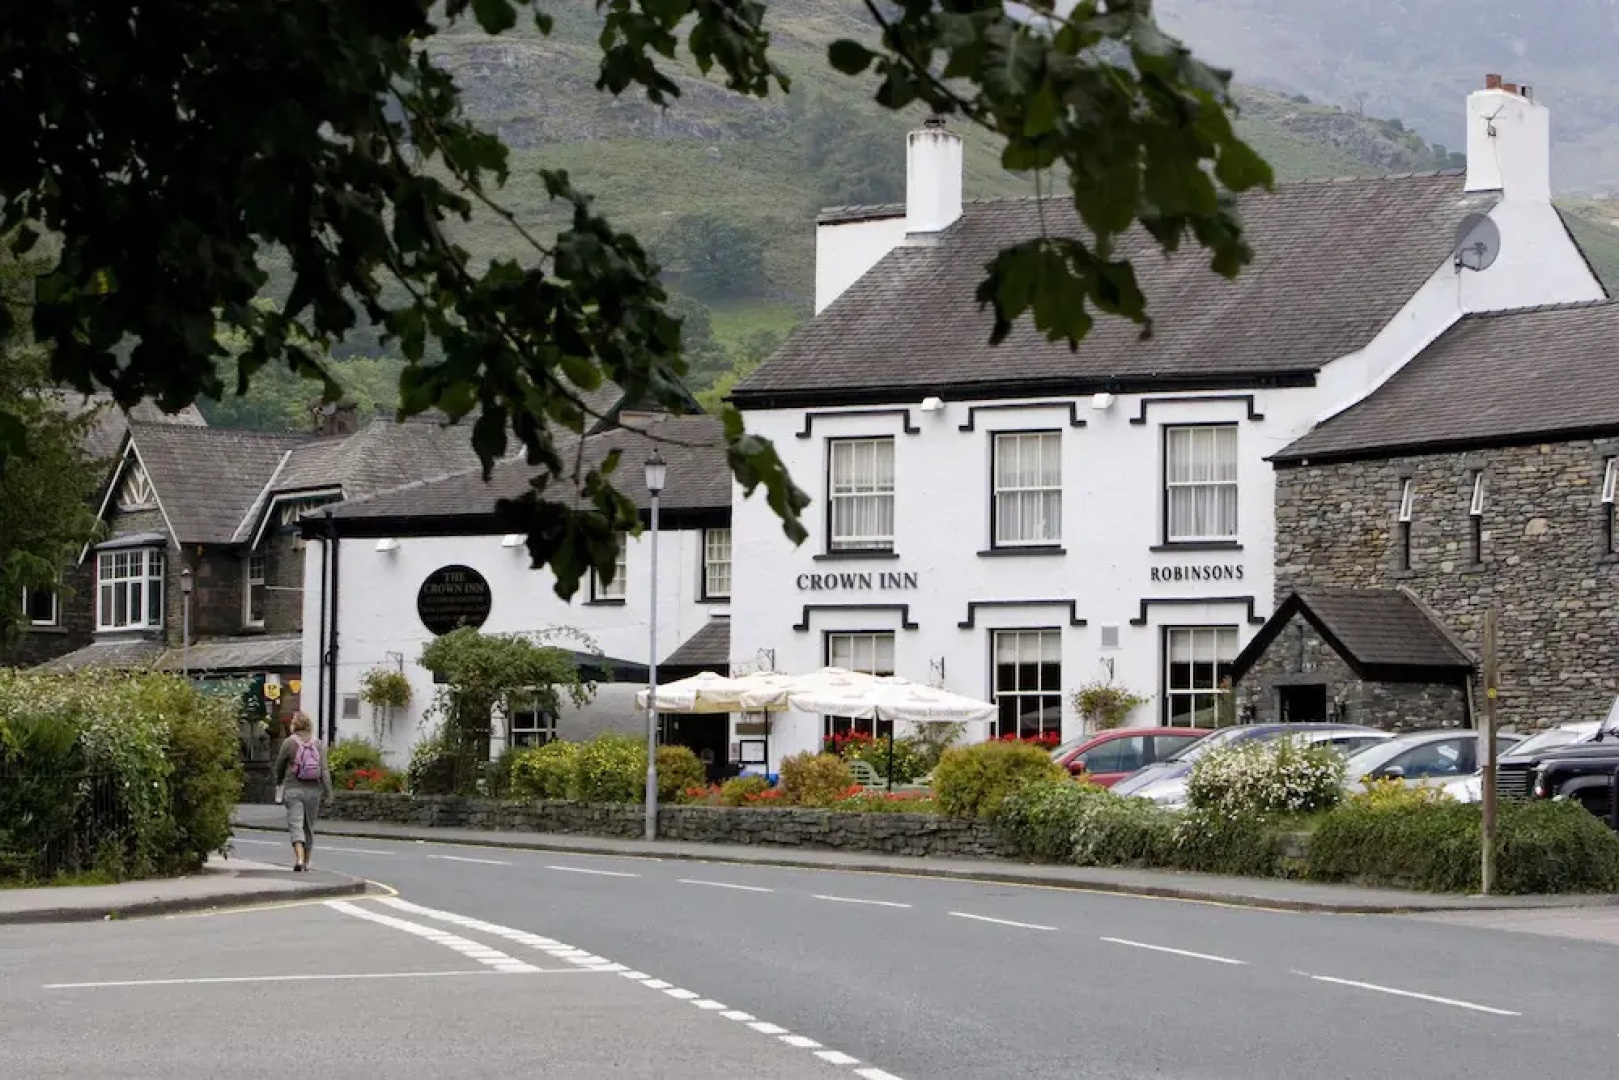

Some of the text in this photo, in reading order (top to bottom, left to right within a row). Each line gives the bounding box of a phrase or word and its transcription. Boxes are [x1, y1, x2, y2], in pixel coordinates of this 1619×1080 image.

[444, 572, 466, 582] THE
[1150, 564, 1244, 581] ROBINSONS
[424, 582, 485, 594] CROWN INN
[796, 572, 918, 590] CROWN INN
